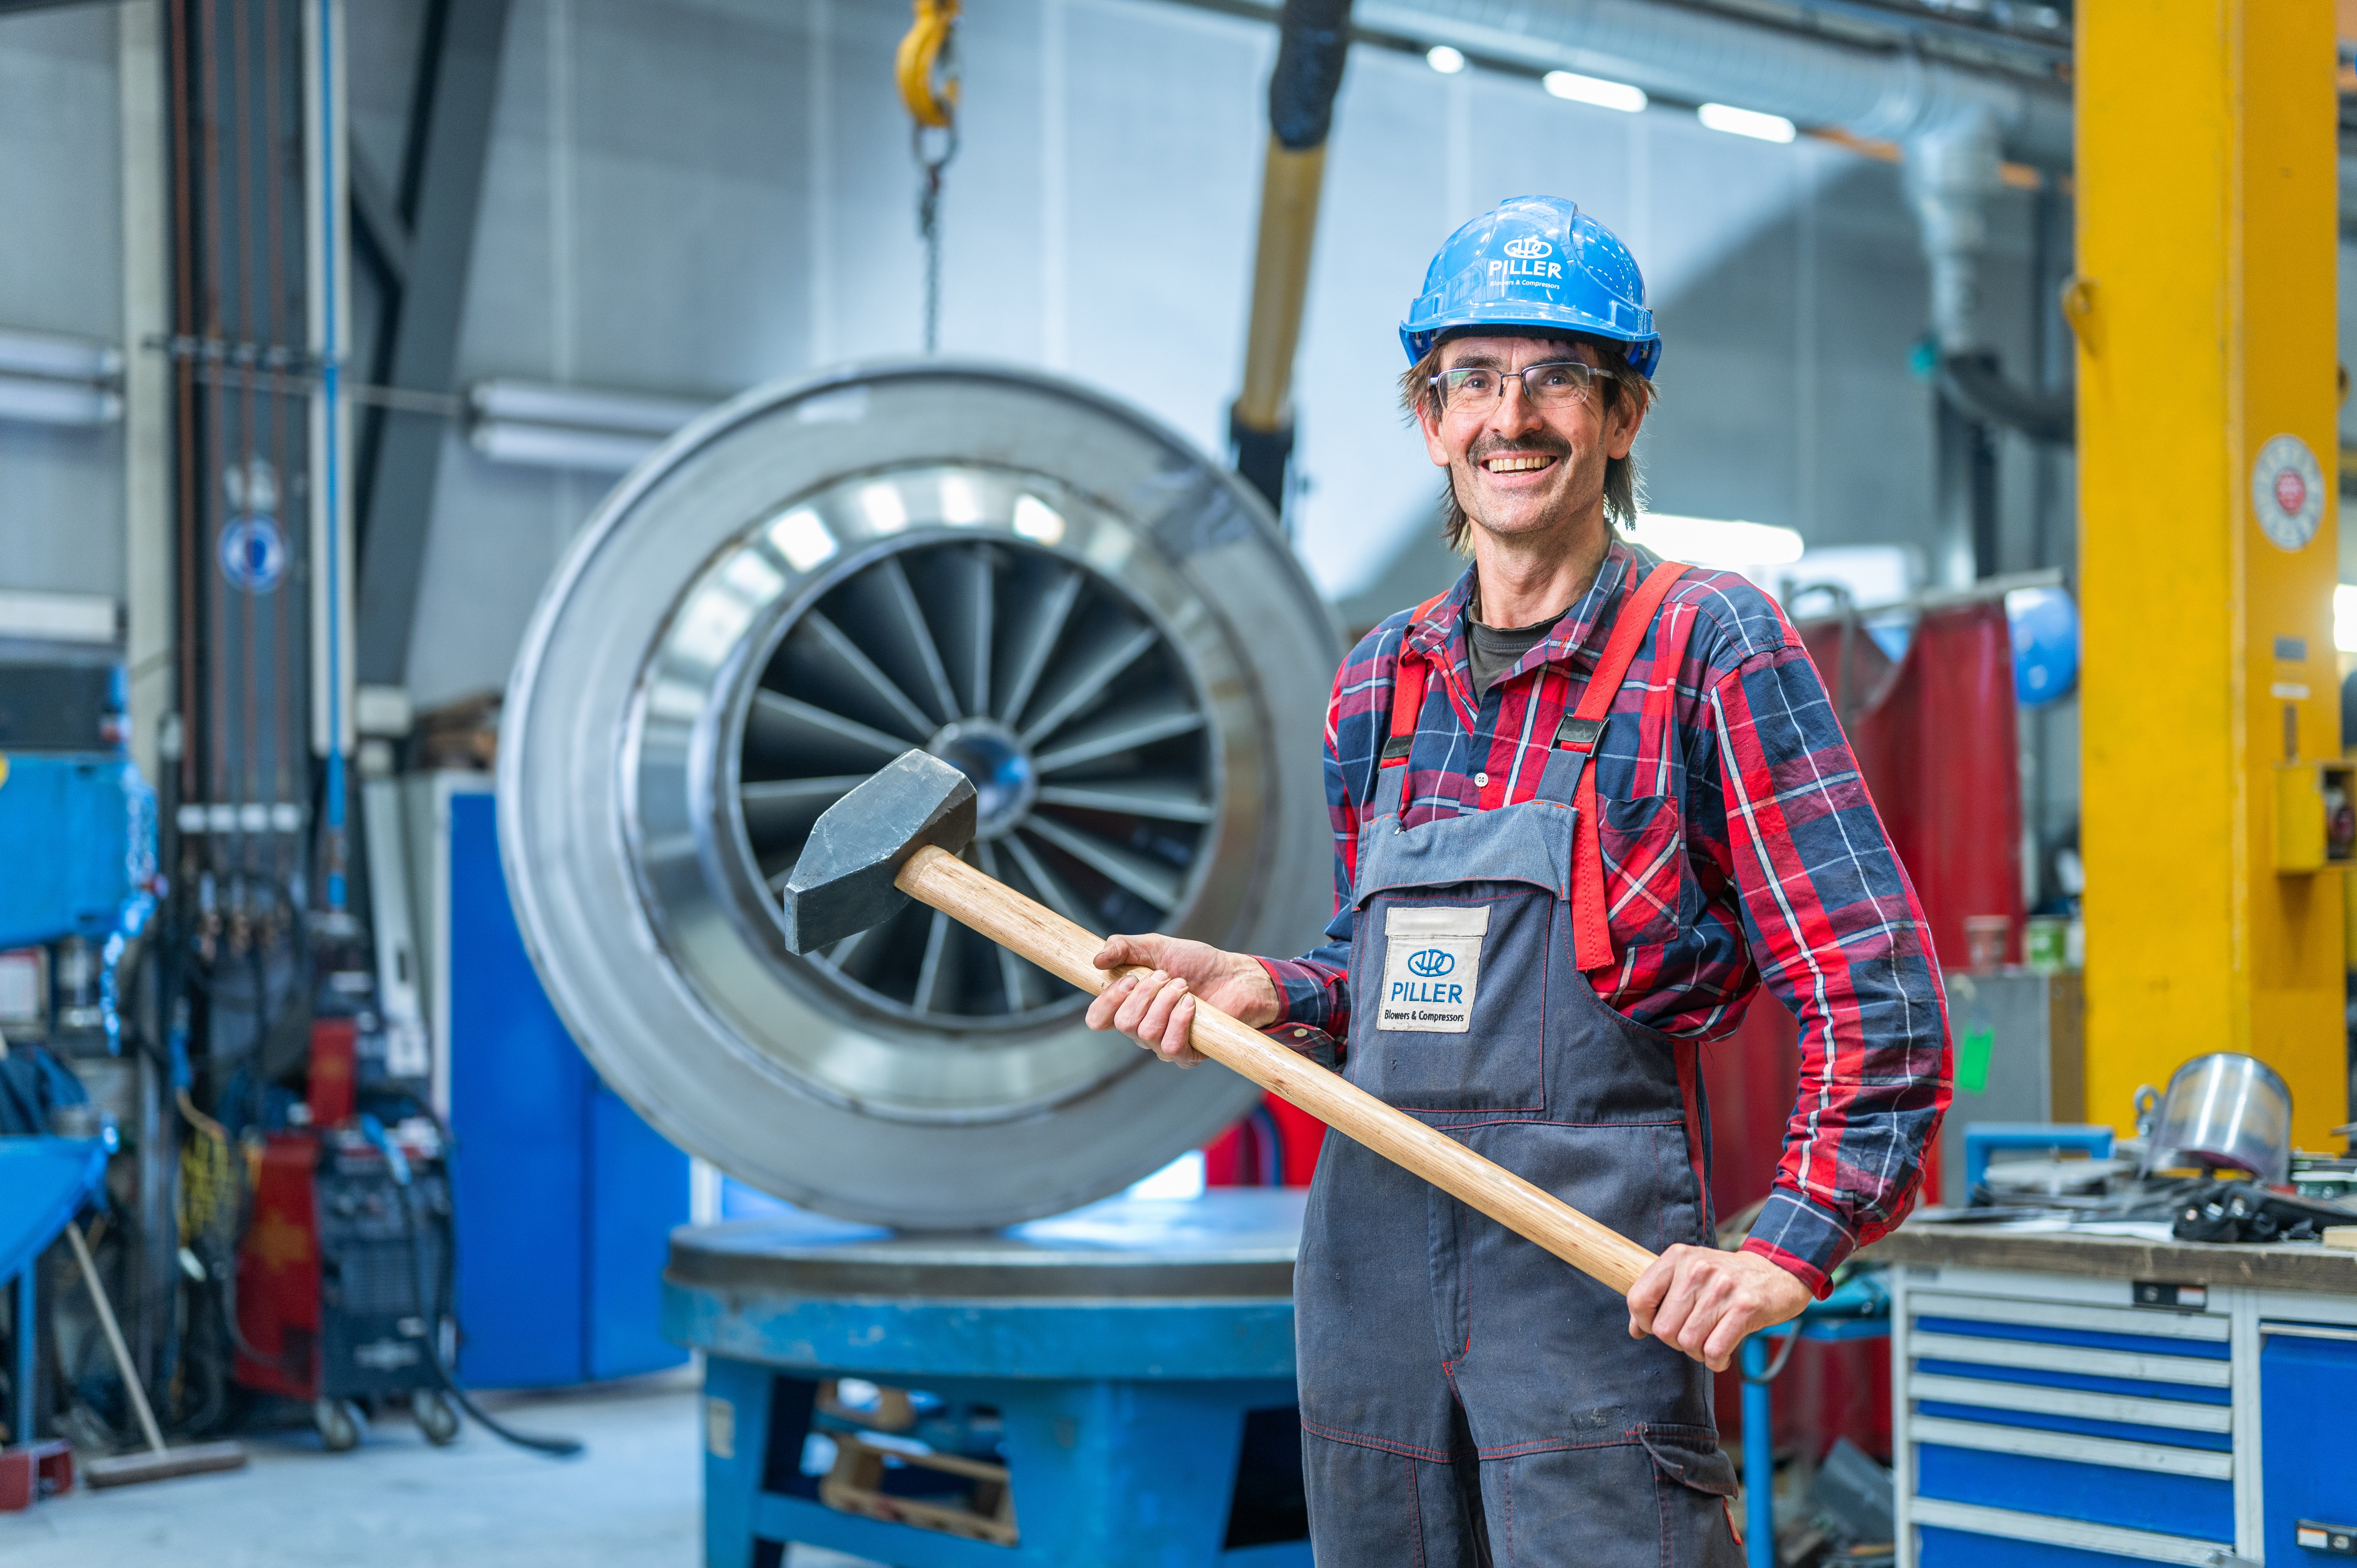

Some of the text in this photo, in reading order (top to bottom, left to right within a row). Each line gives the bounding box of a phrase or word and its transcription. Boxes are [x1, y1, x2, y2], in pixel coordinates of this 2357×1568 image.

[1489, 260, 1562, 279] PILLER
[1521, 280, 1560, 290] Compressors
[1391, 982, 1462, 1004] PILLER
[1384, 1009, 1464, 1022] Blowers & Compressors
